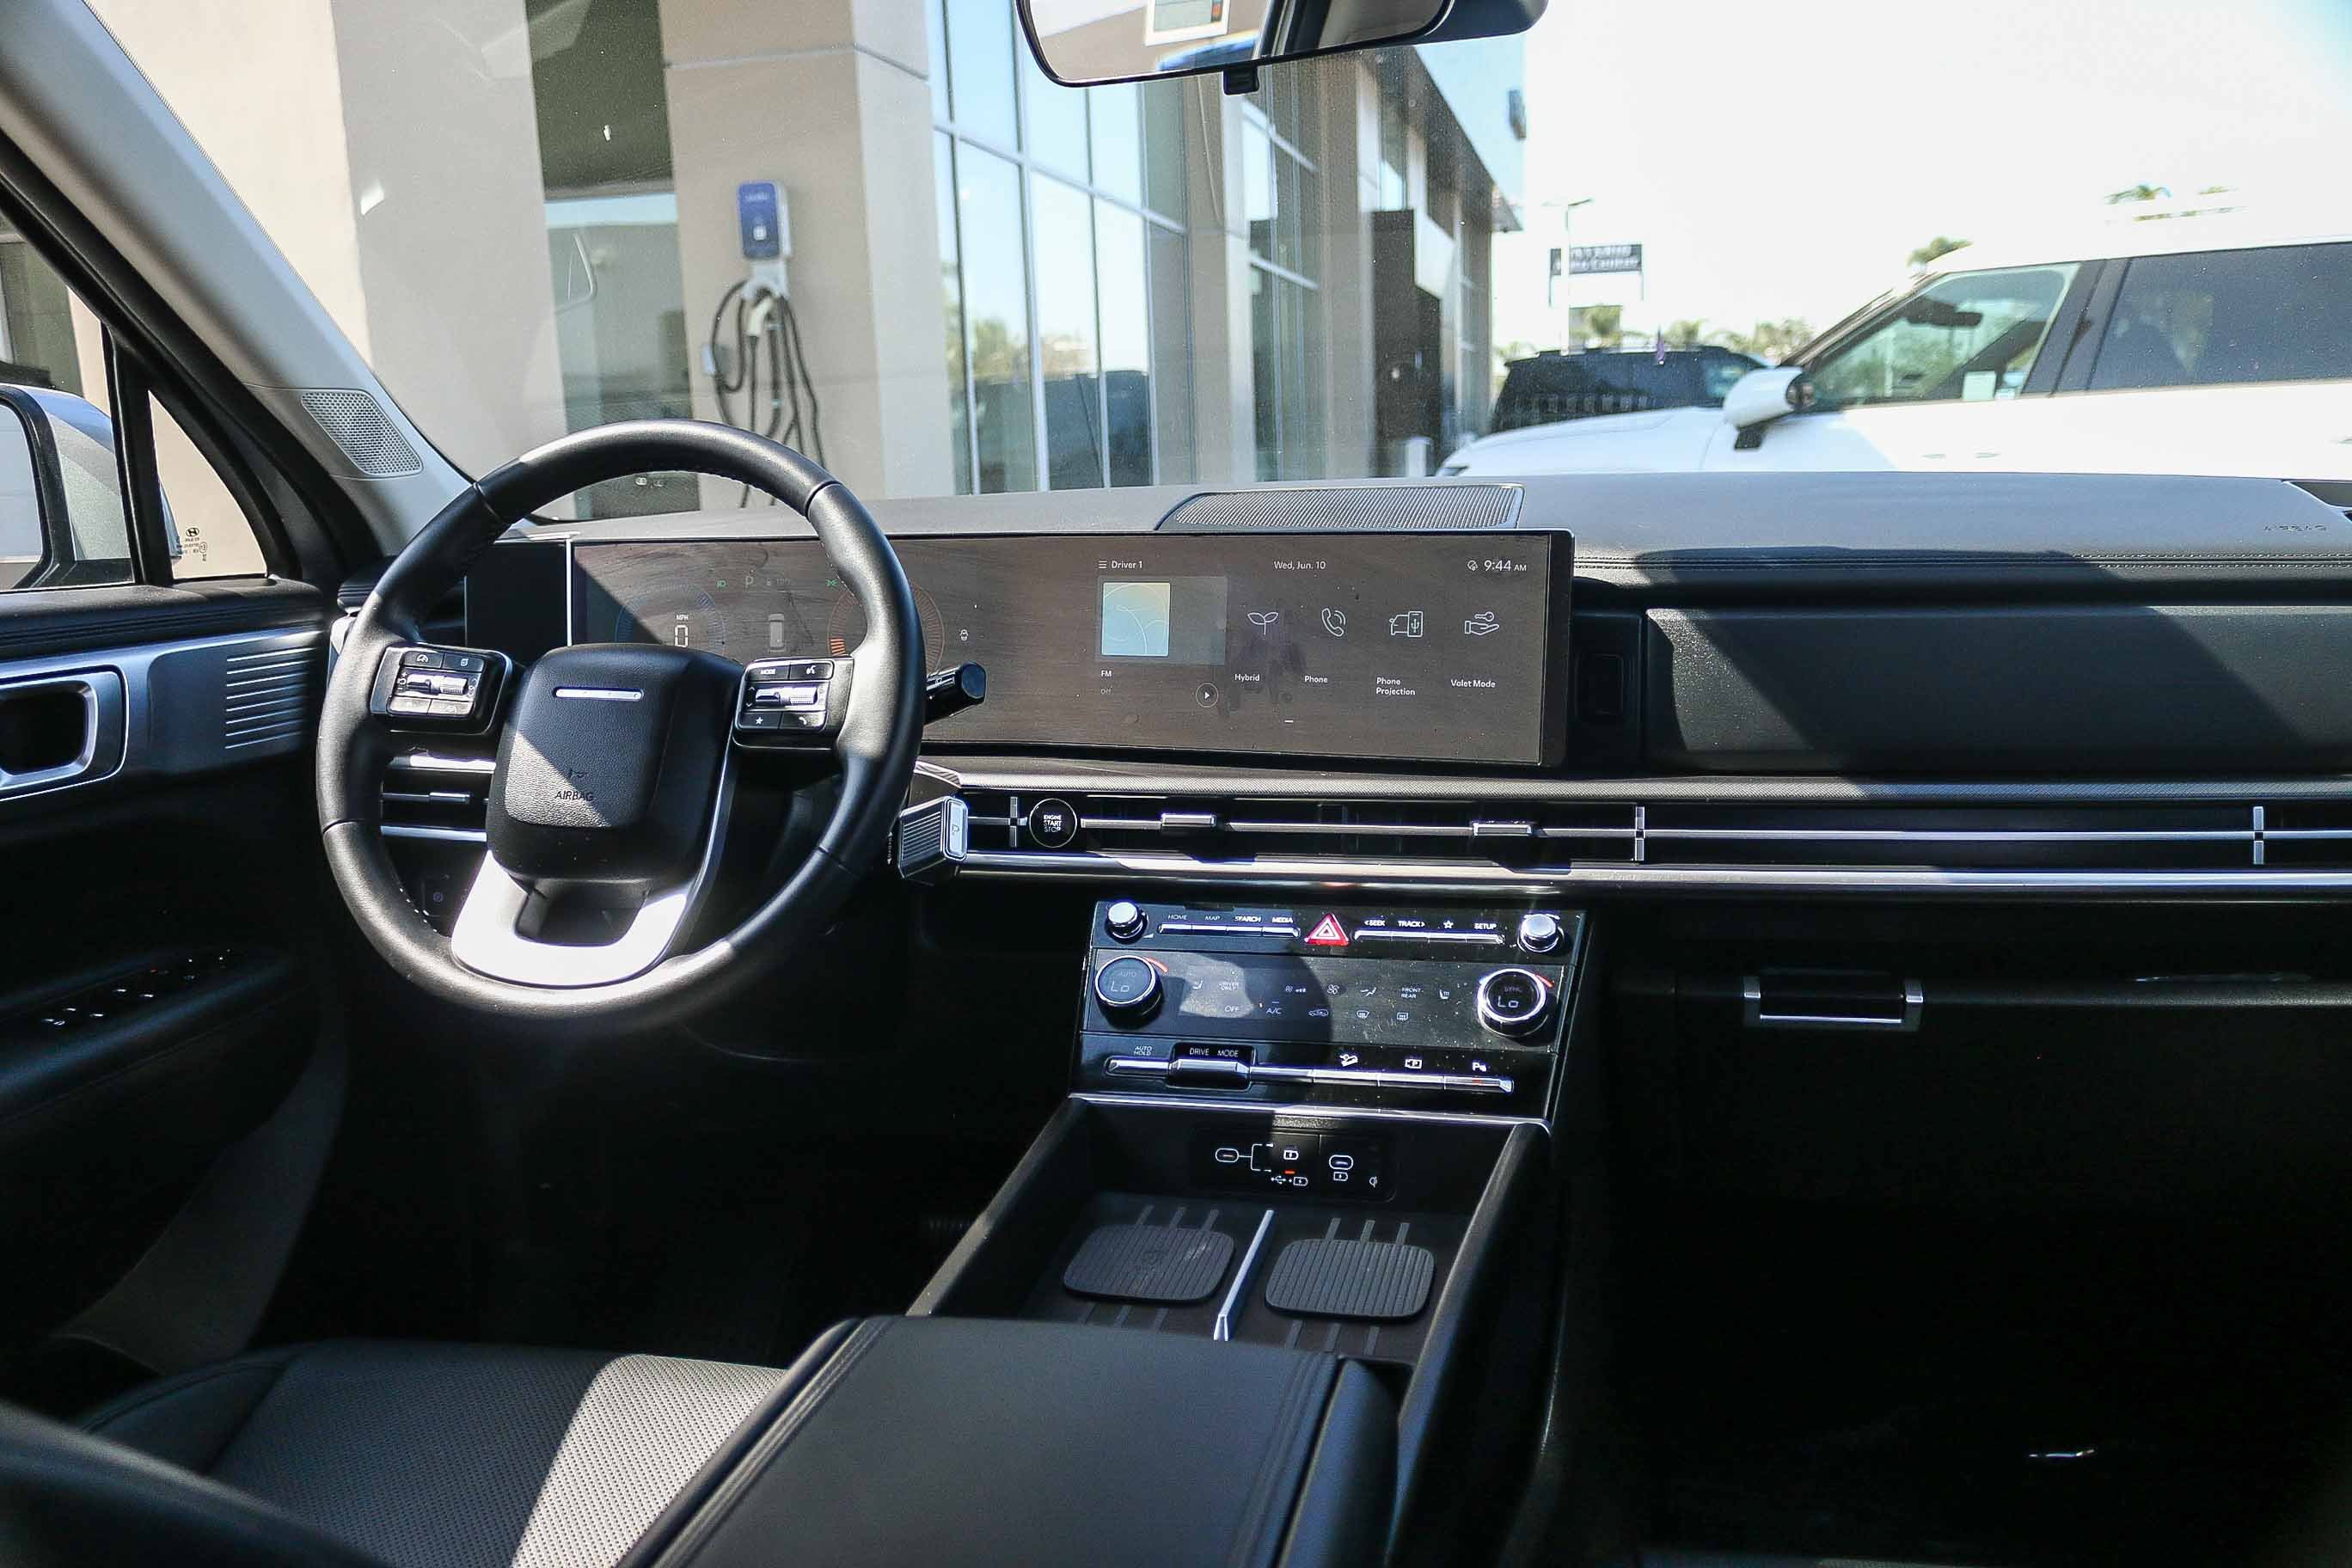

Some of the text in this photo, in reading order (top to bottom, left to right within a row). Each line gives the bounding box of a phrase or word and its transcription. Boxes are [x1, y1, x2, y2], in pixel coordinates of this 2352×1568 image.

[1111, 560, 1142, 569] Driver 1
[1273, 560, 1326, 570] Wed, Jun. 10
[1484, 560, 1511, 571] 9:44
[1234, 674, 1260, 683] Hybrid
[1304, 675, 1328, 683] Phone
[1376, 677, 1401, 685] Phone
[1450, 678, 1496, 688] Valet Mode
[1375, 687, 1416, 695] Projection
[554, 790, 593, 801] AIRBAG
[1189, 1047, 1210, 1056] DRIVE
